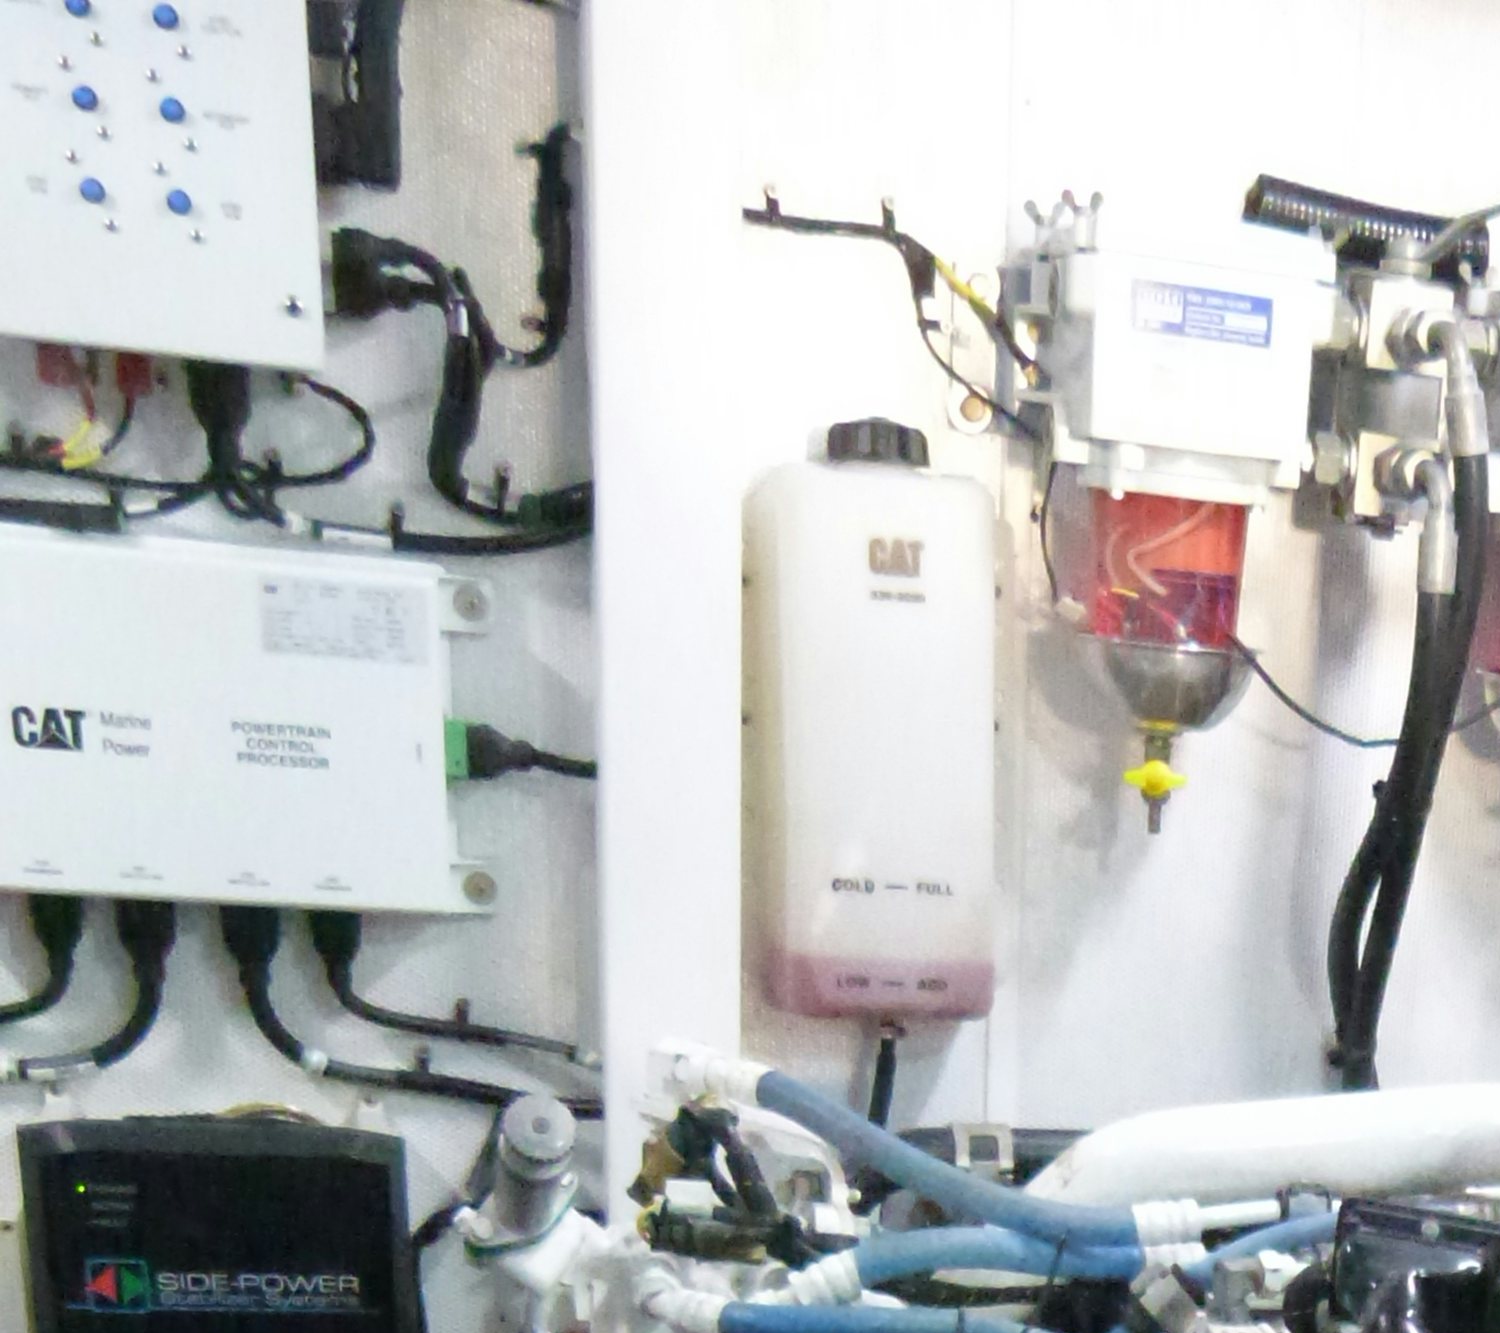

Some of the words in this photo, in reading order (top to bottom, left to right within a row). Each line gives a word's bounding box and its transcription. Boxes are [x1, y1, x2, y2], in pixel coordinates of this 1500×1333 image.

[867, 537, 926, 578] CAT
[11, 704, 86, 752] CAT
[99, 710, 152, 731] Marine
[231, 720, 332, 740] POWERTRAIN
[102, 737, 150, 758] Power
[246, 737, 315, 754] CONTROL
[236, 752, 330, 770] PROCESSOR
[831, 878, 876, 894] COLD
[916, 882, 954, 897] FULL
[157, 1272, 361, 1294] SIDE-POWER
